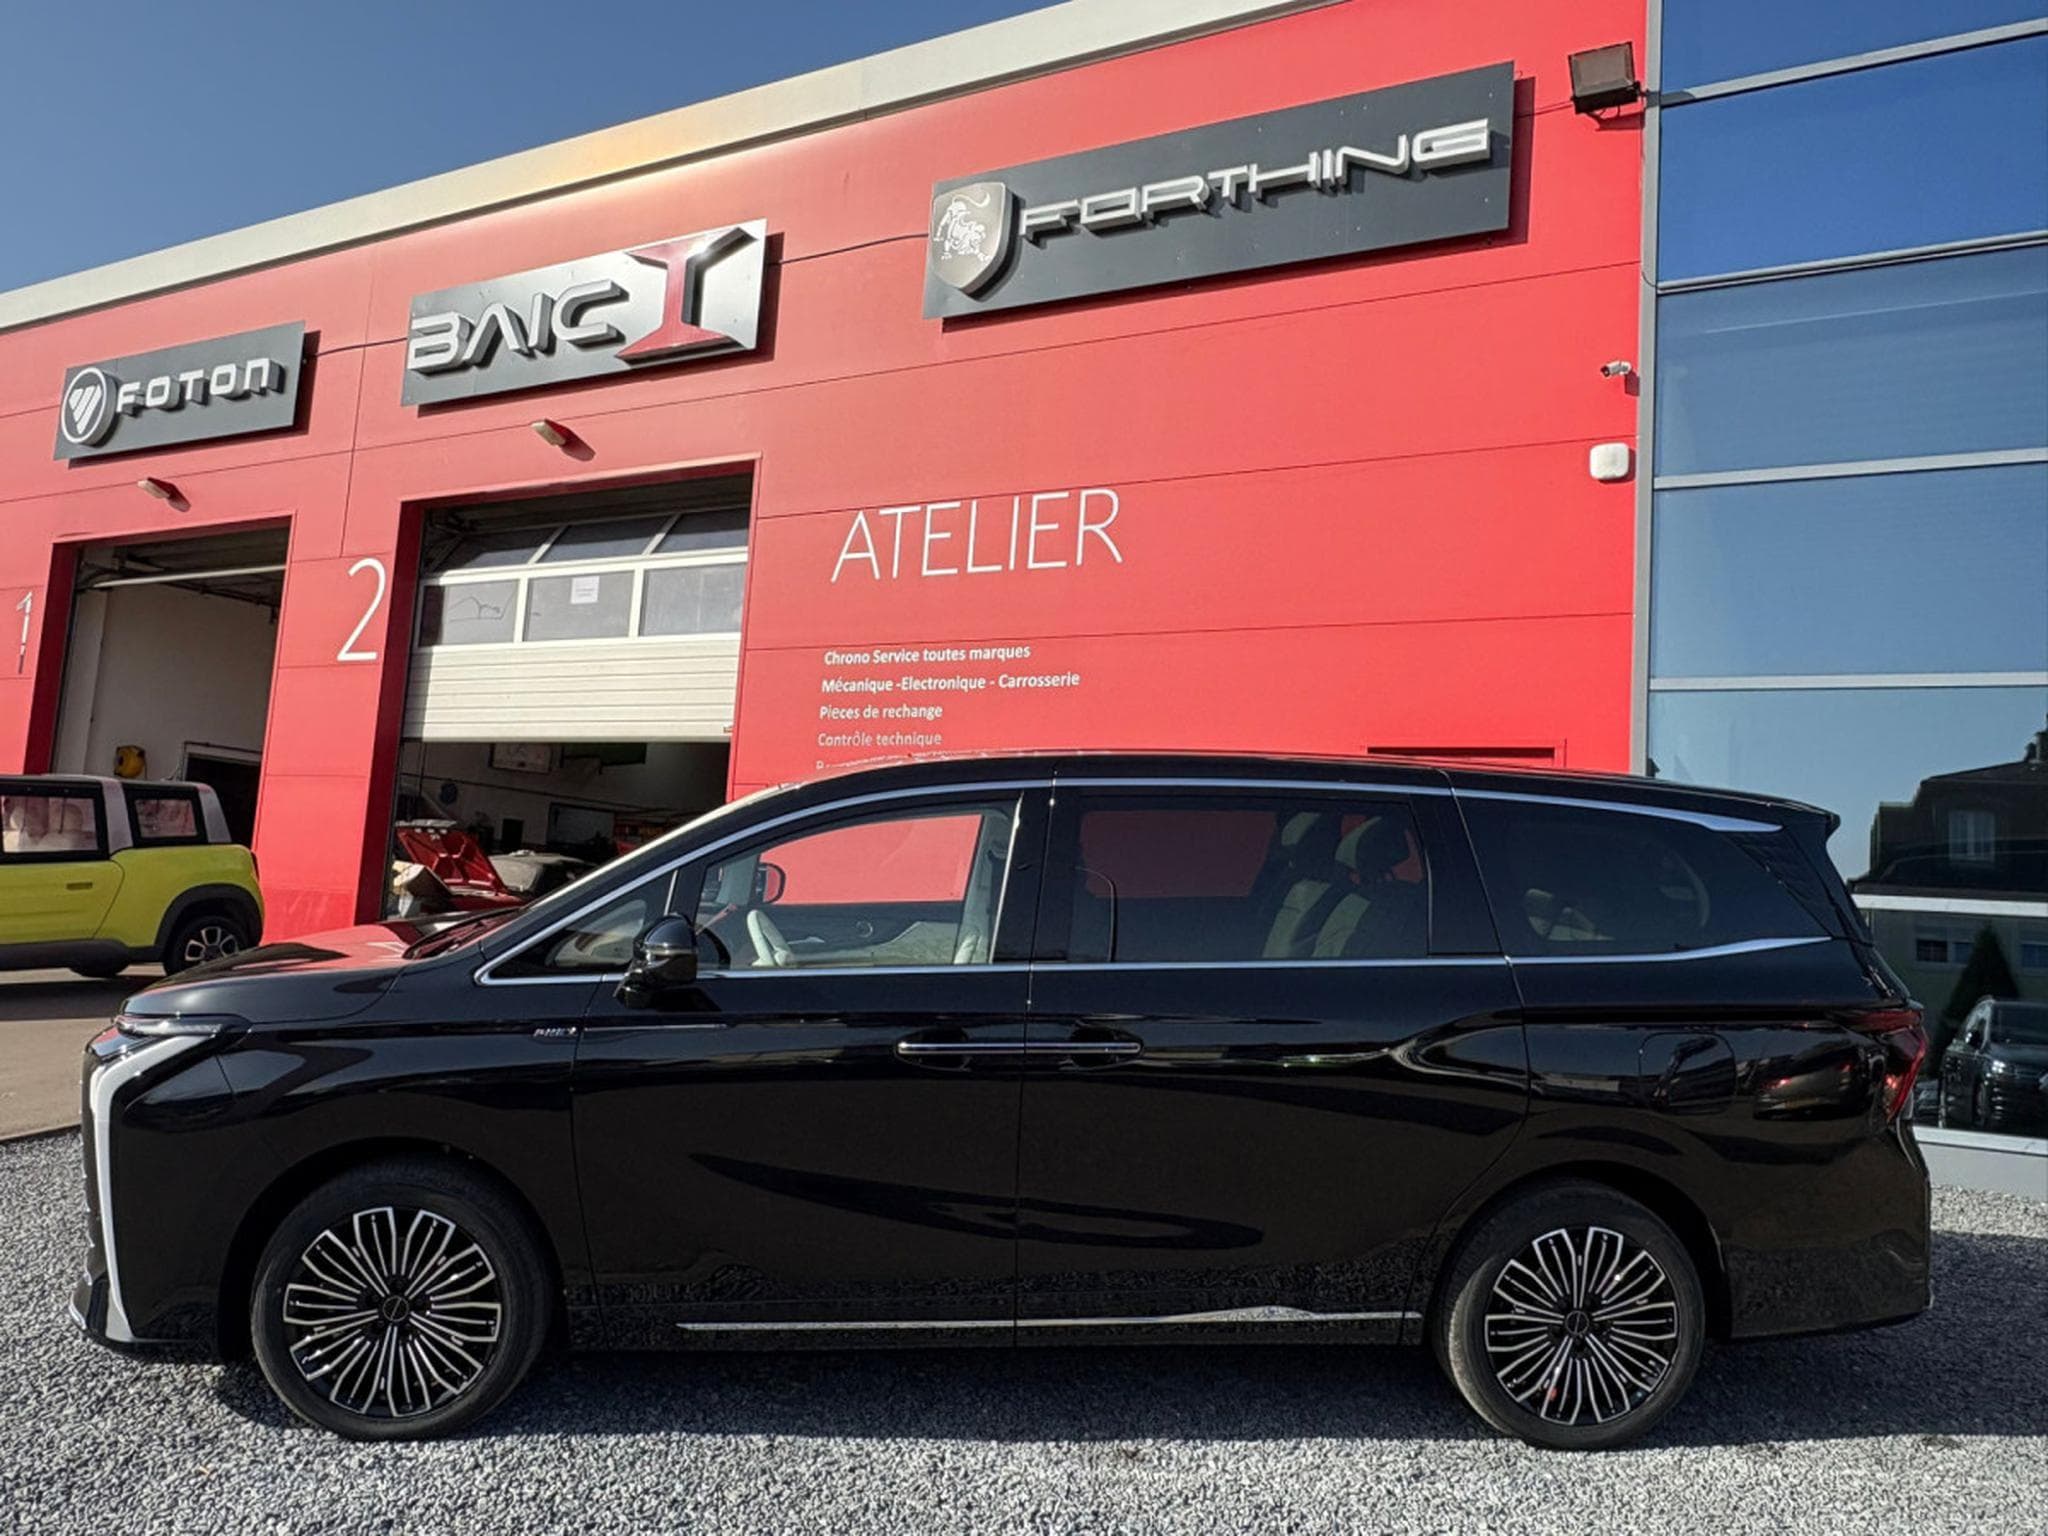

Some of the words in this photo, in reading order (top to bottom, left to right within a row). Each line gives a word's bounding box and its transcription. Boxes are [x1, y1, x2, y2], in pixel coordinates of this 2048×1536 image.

[1020, 118, 1490, 239] FORTHING
[407, 279, 630, 376] BAIC
[831, 488, 1123, 583] ATELIER
[337, 558, 386, 661] 2
[821, 676, 894, 694] Mécanique
[998, 671, 1080, 688] Carrosserie
[824, 650, 870, 665] Chrono
[873, 649, 920, 664] Service
[923, 648, 966, 662] toutes
[969, 646, 1031, 662] marques
[818, 730, 873, 746] Contrôle
[876, 731, 942, 748] technique
[862, 704, 880, 719] de
[882, 703, 943, 721] rechange
